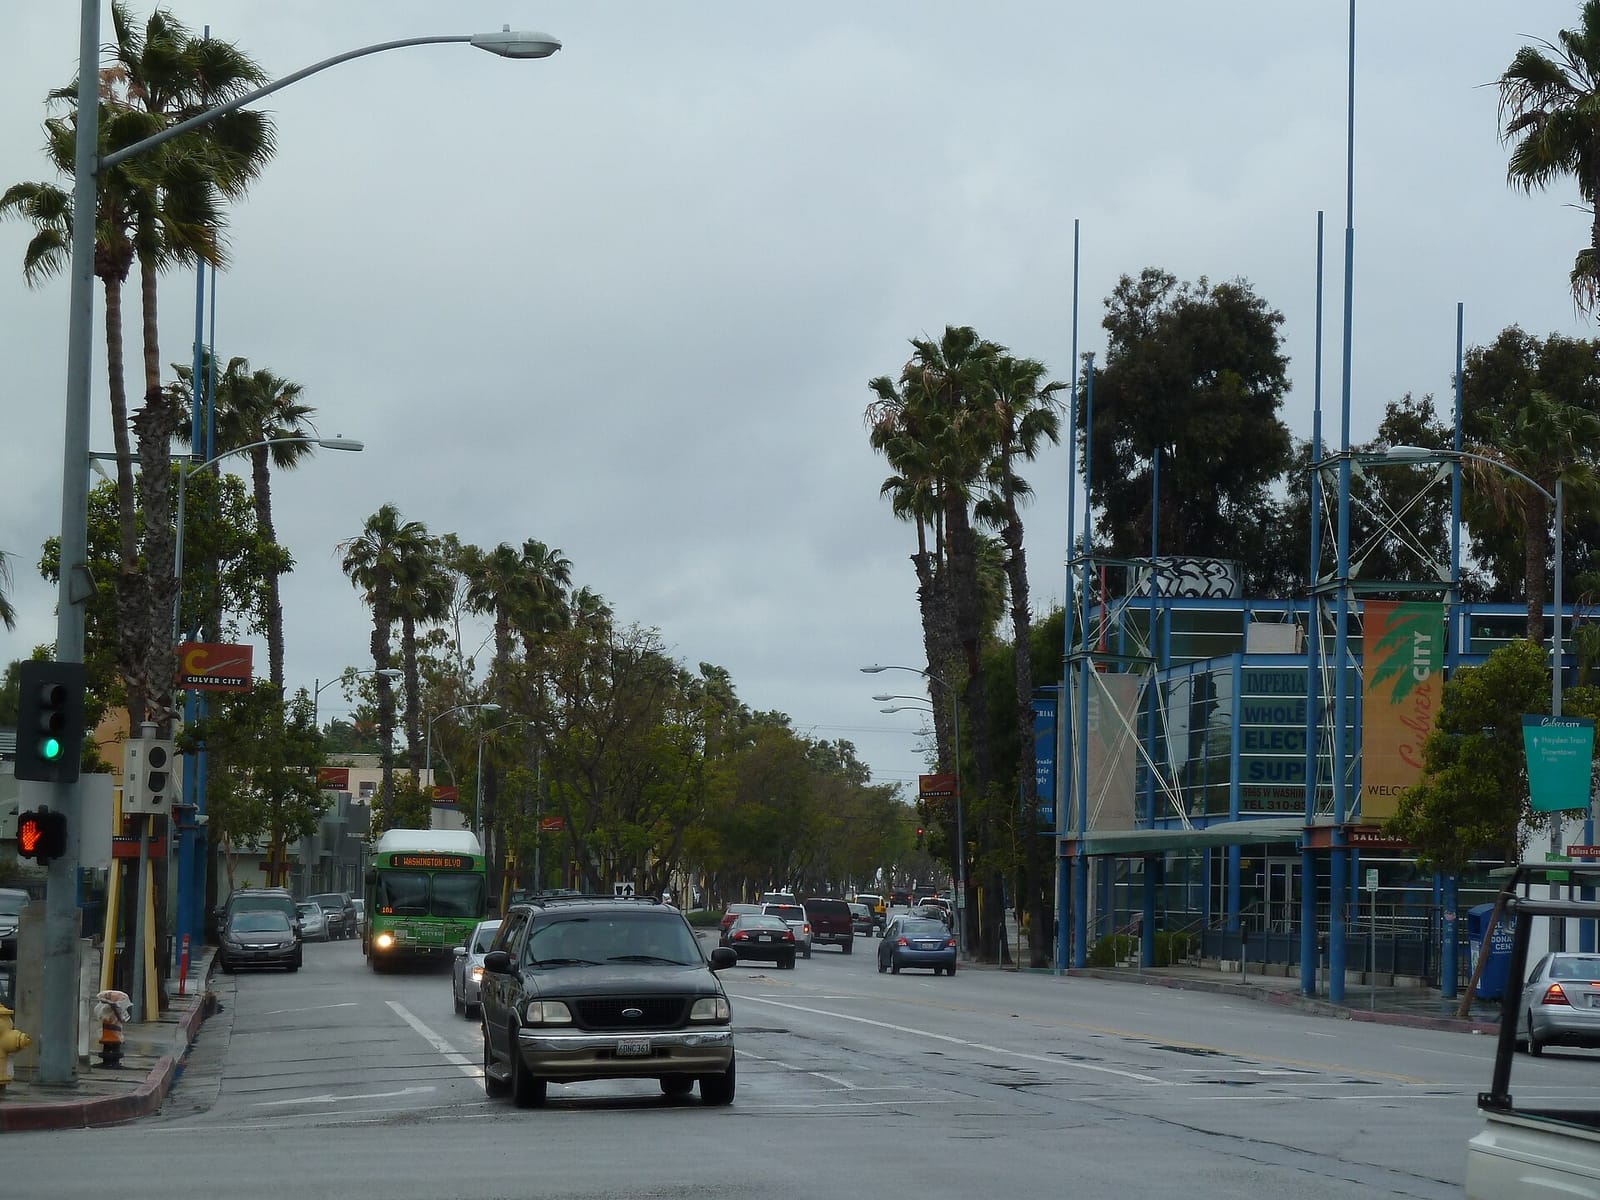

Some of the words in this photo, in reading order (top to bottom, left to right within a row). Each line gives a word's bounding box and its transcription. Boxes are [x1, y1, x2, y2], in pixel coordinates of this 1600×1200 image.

[1413, 631, 1431, 681] CITY
[187, 676, 220, 684] CULVER
[1246, 673, 1308, 692] IMPERIA
[1244, 800, 1264, 810] TEL
[394, 856, 400, 867] 1
[403, 857, 443, 868] WASHINGTON
[444, 859, 461, 868] BLVD
